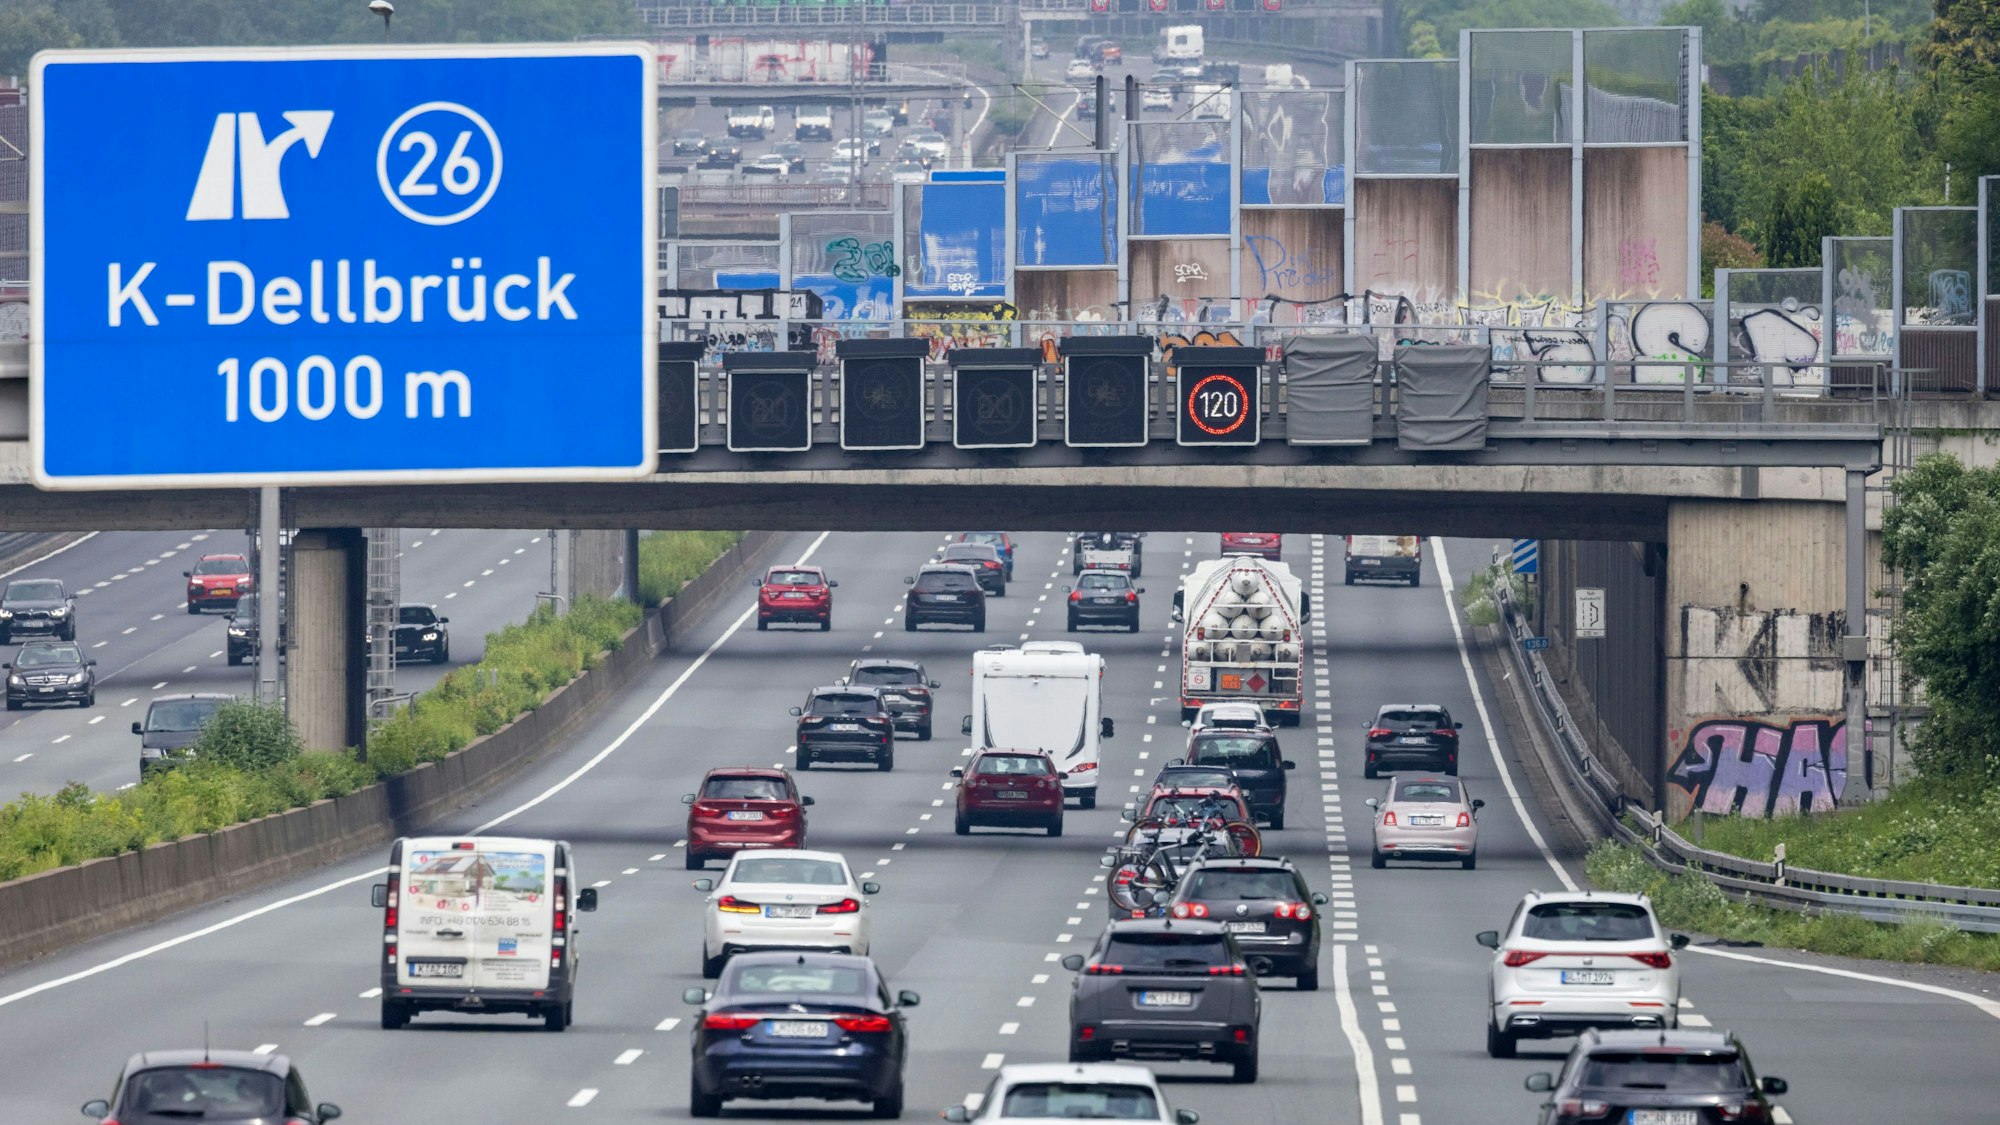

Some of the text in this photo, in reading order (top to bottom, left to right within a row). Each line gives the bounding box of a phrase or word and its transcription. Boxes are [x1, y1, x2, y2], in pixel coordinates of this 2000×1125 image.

[397, 131, 482, 196] 26
[107, 256, 579, 328] K-Dellbrück
[218, 356, 472, 423] 1000 m
[1200, 391, 1237, 418] 120
